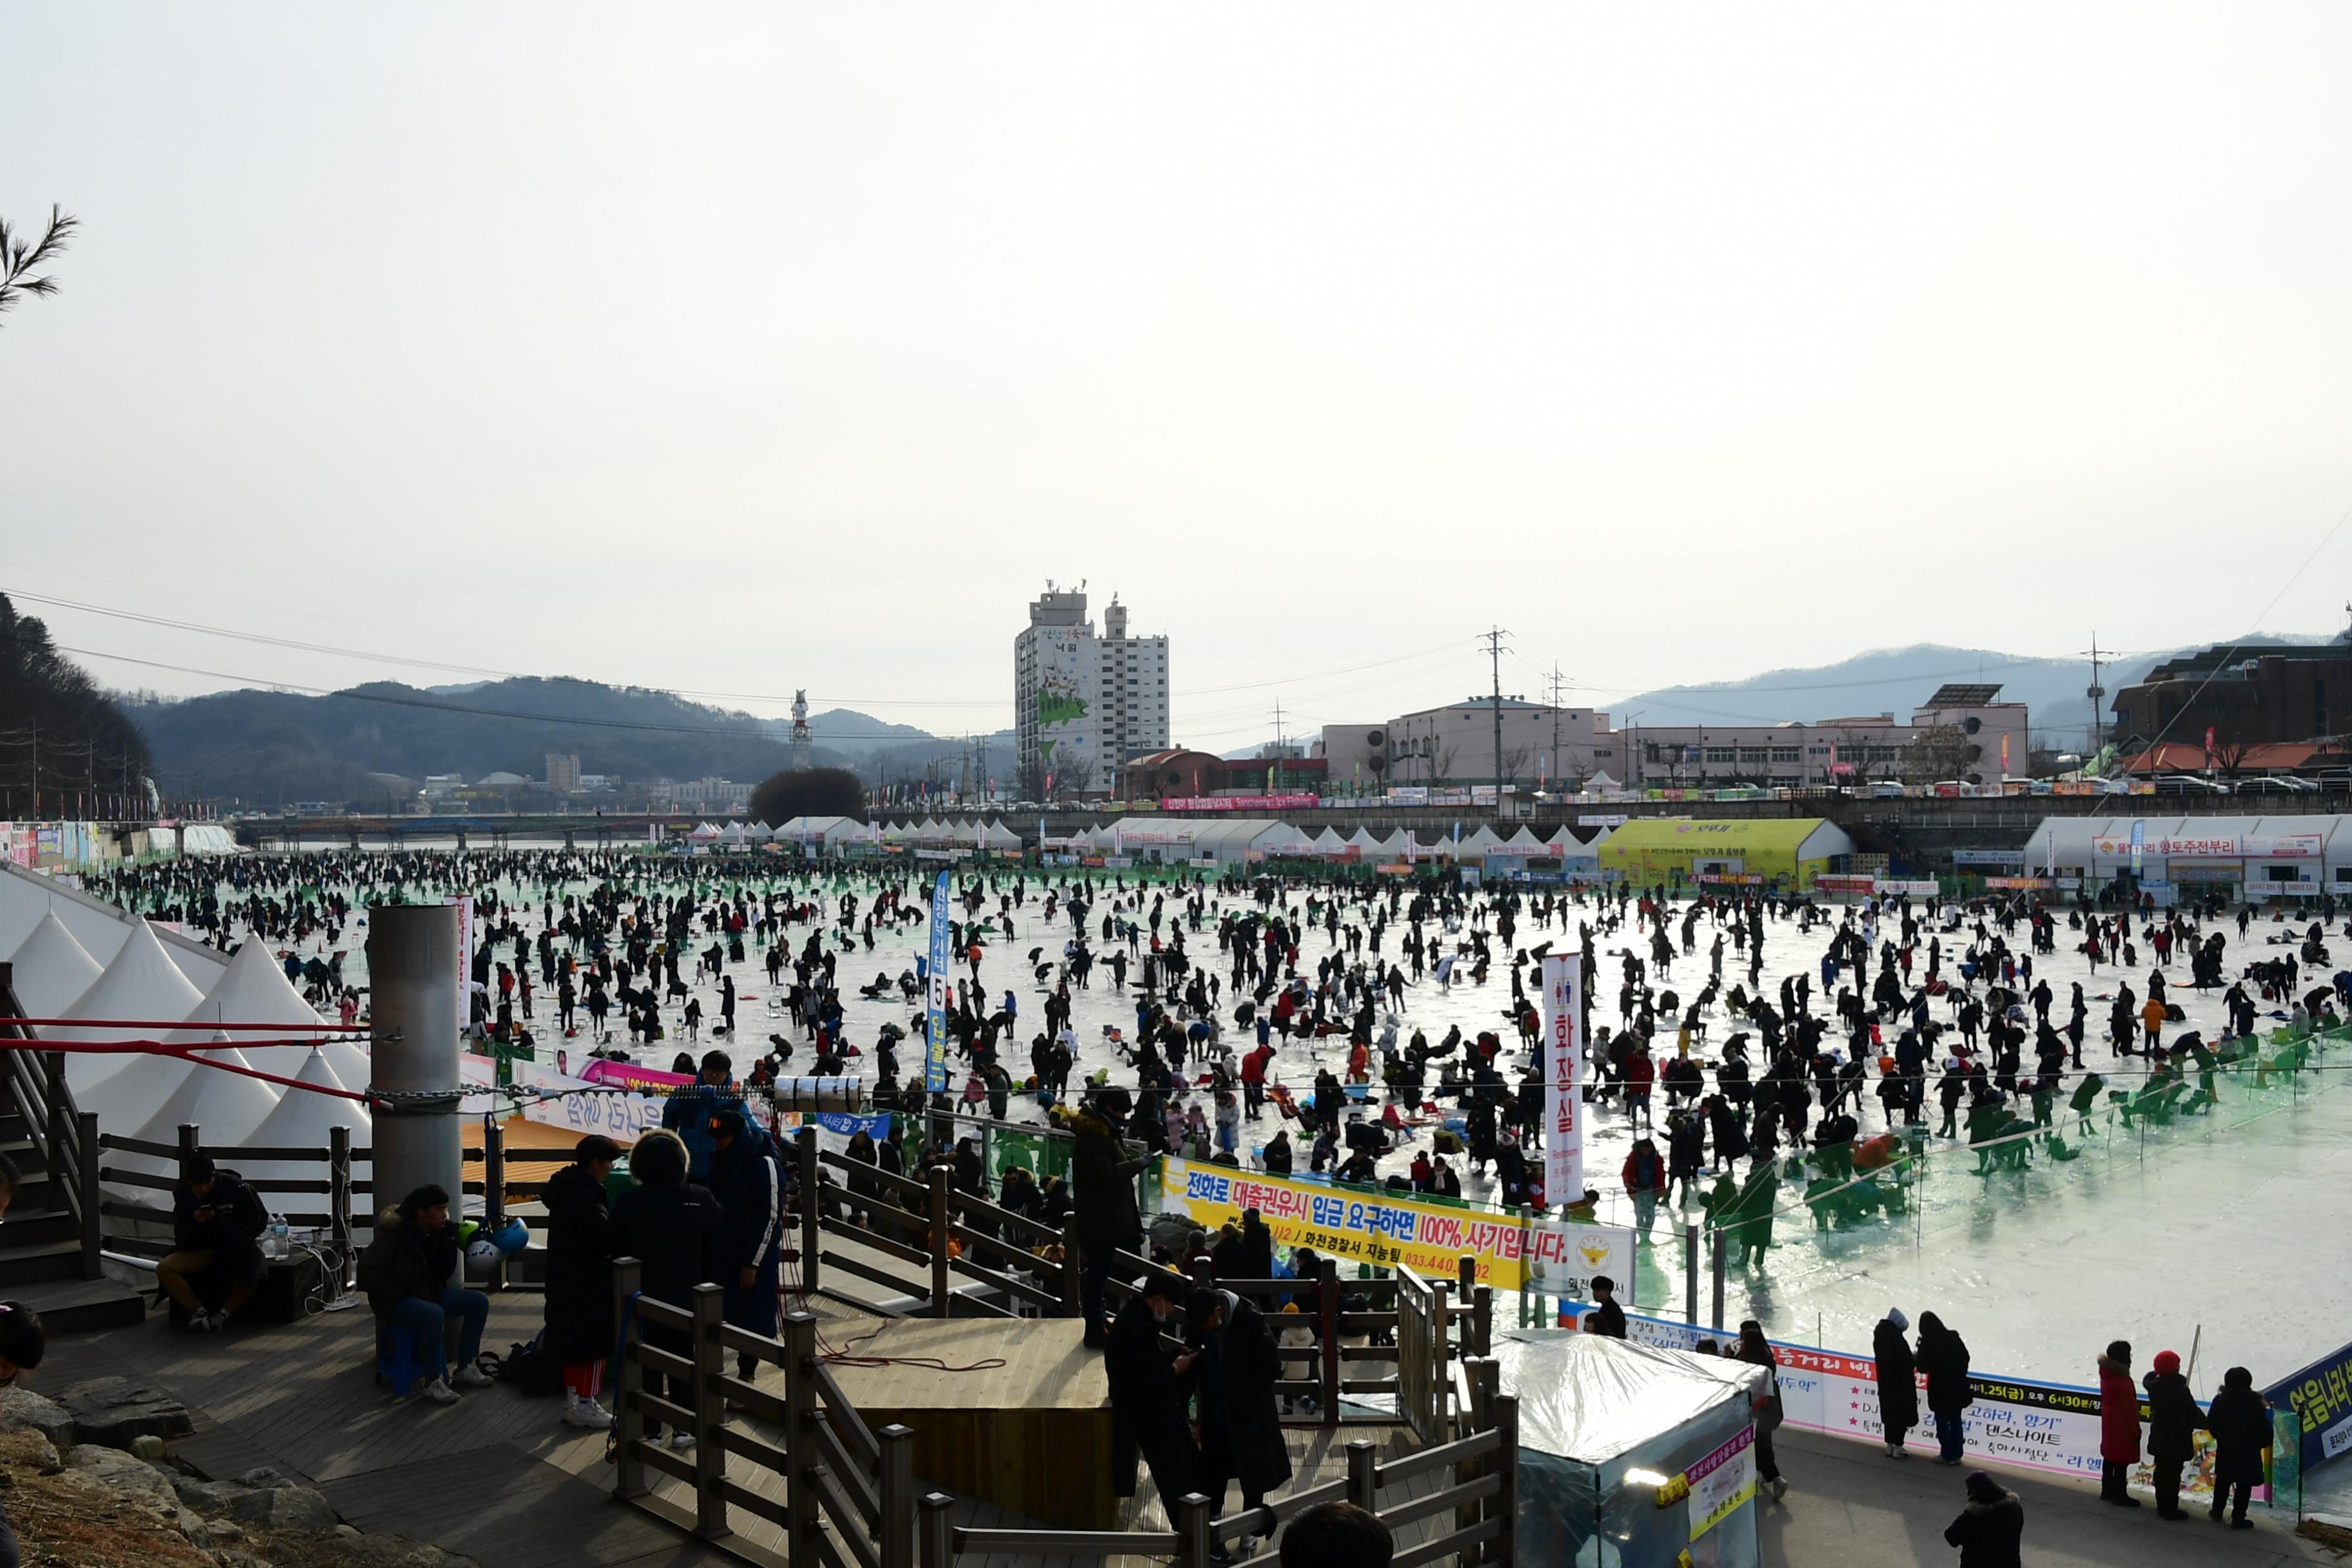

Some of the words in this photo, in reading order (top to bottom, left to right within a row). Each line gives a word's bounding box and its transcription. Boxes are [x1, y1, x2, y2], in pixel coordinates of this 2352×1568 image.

[1275, 797, 1286, 807] Ice
[1286, 796, 1311, 808] Fishing
[2160, 839, 2234, 854] 향토주전부리
[935, 977, 943, 1006] 5
[1554, 1014, 1574, 1133] 화장실
[1553, 1148, 1578, 1159] Restroom
[1187, 1171, 1230, 1202] 전화로
[1233, 1181, 1309, 1221] 대출권유시
[1312, 1196, 1344, 1228] 입금
[1347, 1203, 1416, 1242] 요구하면
[1418, 1216, 1462, 1248] 100%
[1465, 1222, 1568, 1264] 사기입니다.
[1274, 1225, 1292, 1240] 112
[1304, 1231, 1361, 1255] 화천경찰서
[1366, 1242, 1402, 1263] 지능팀
[1405, 1253, 1490, 1279] 033.440.02
[1568, 1277, 1624, 1293] 화천서
[2028, 1391, 2044, 1402] 오후
[1863, 1403, 1878, 1414] DJ
[1986, 1423, 2061, 1446] 댄스나이트
